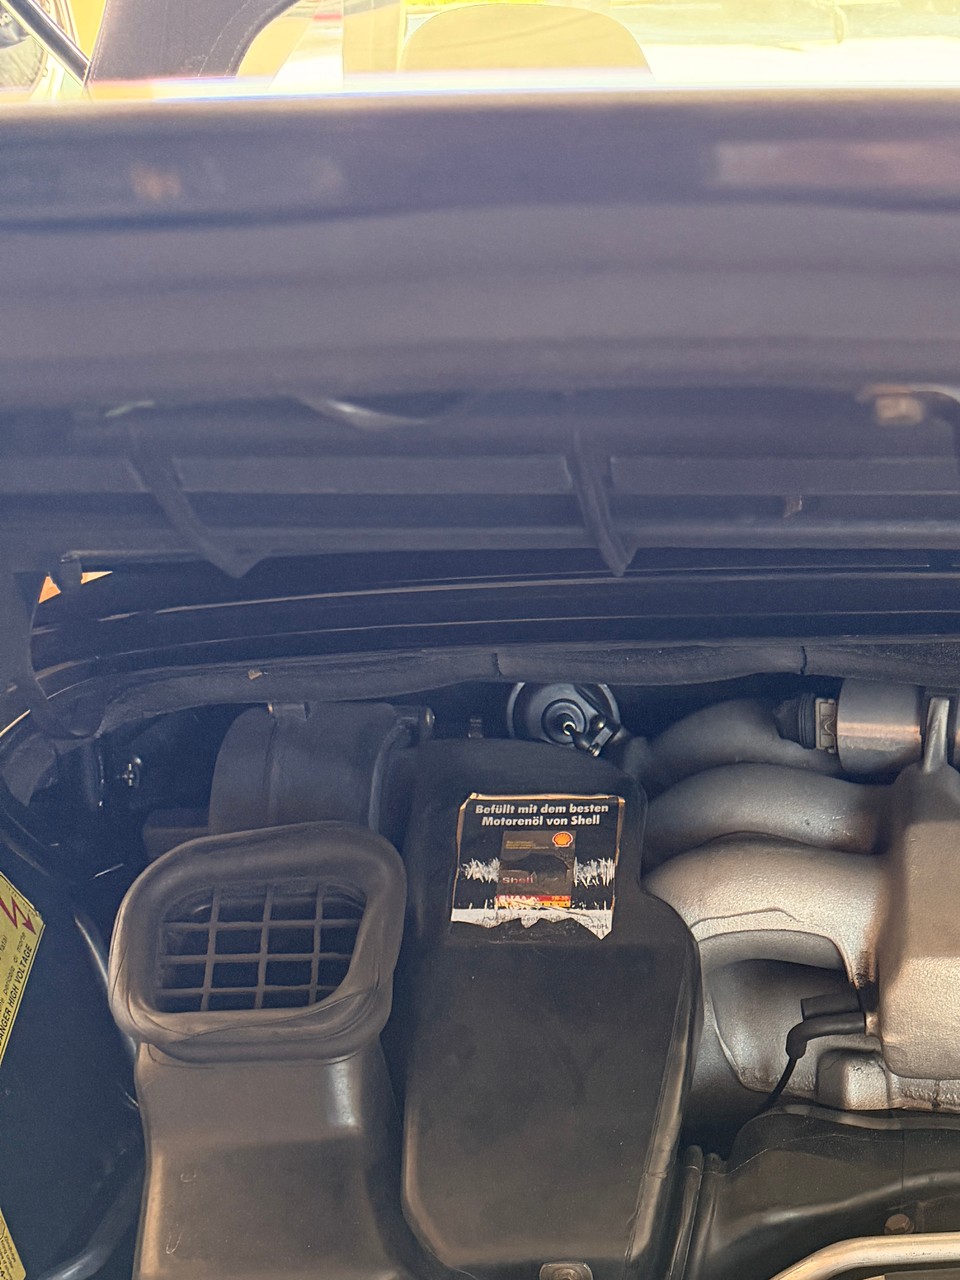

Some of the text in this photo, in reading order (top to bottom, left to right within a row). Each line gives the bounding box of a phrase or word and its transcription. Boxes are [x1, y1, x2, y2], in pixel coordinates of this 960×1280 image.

[475, 803, 609, 814] Befüllt mit dem besten
[481, 814, 600, 826] Motorenöl von Shell
[8, 984, 20, 1008] HIGH
[14, 944, 33, 984] VOLTAGE
